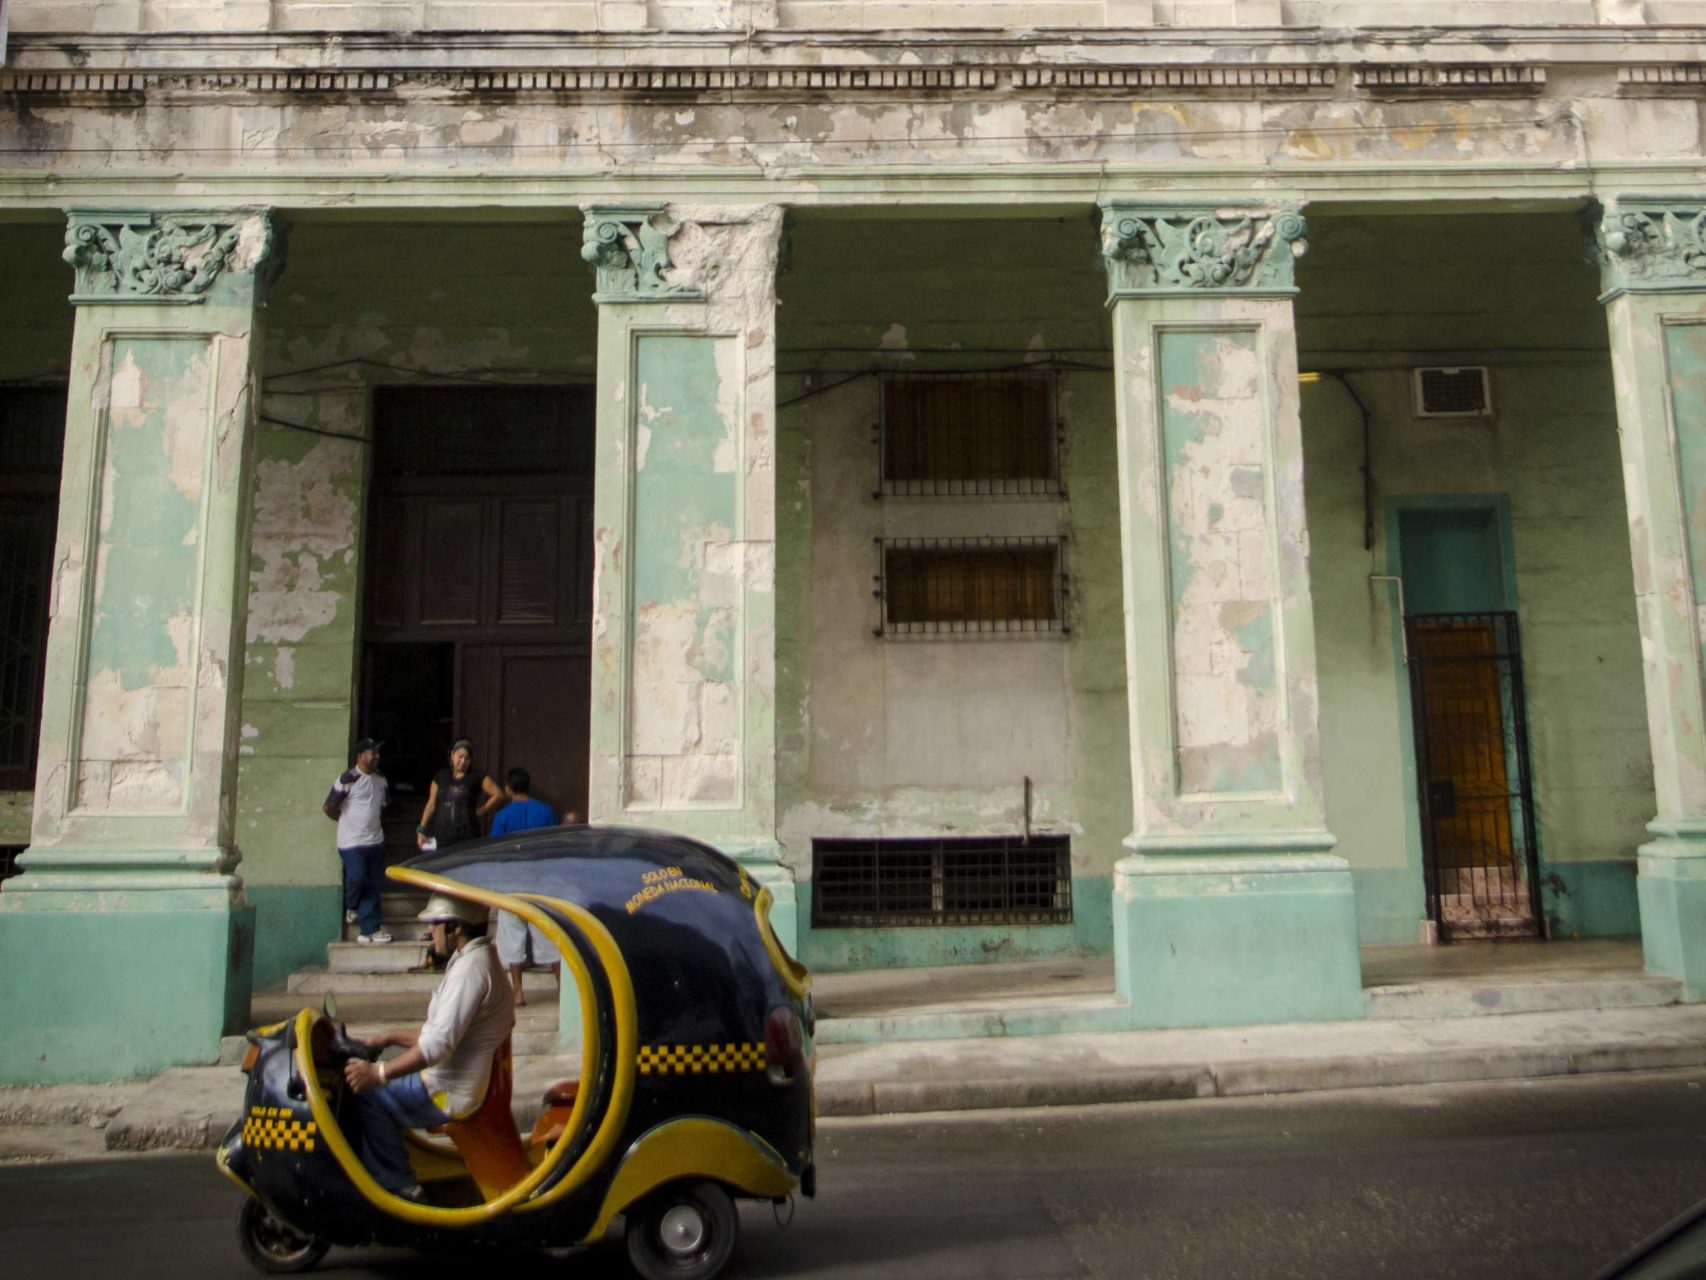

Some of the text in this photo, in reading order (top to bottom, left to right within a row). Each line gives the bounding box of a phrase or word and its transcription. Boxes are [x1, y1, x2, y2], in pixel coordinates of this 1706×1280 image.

[642, 866, 683, 883] SOLO EN
[625, 884, 664, 914] MONEDA
[664, 878, 718, 895] NACIONAL
